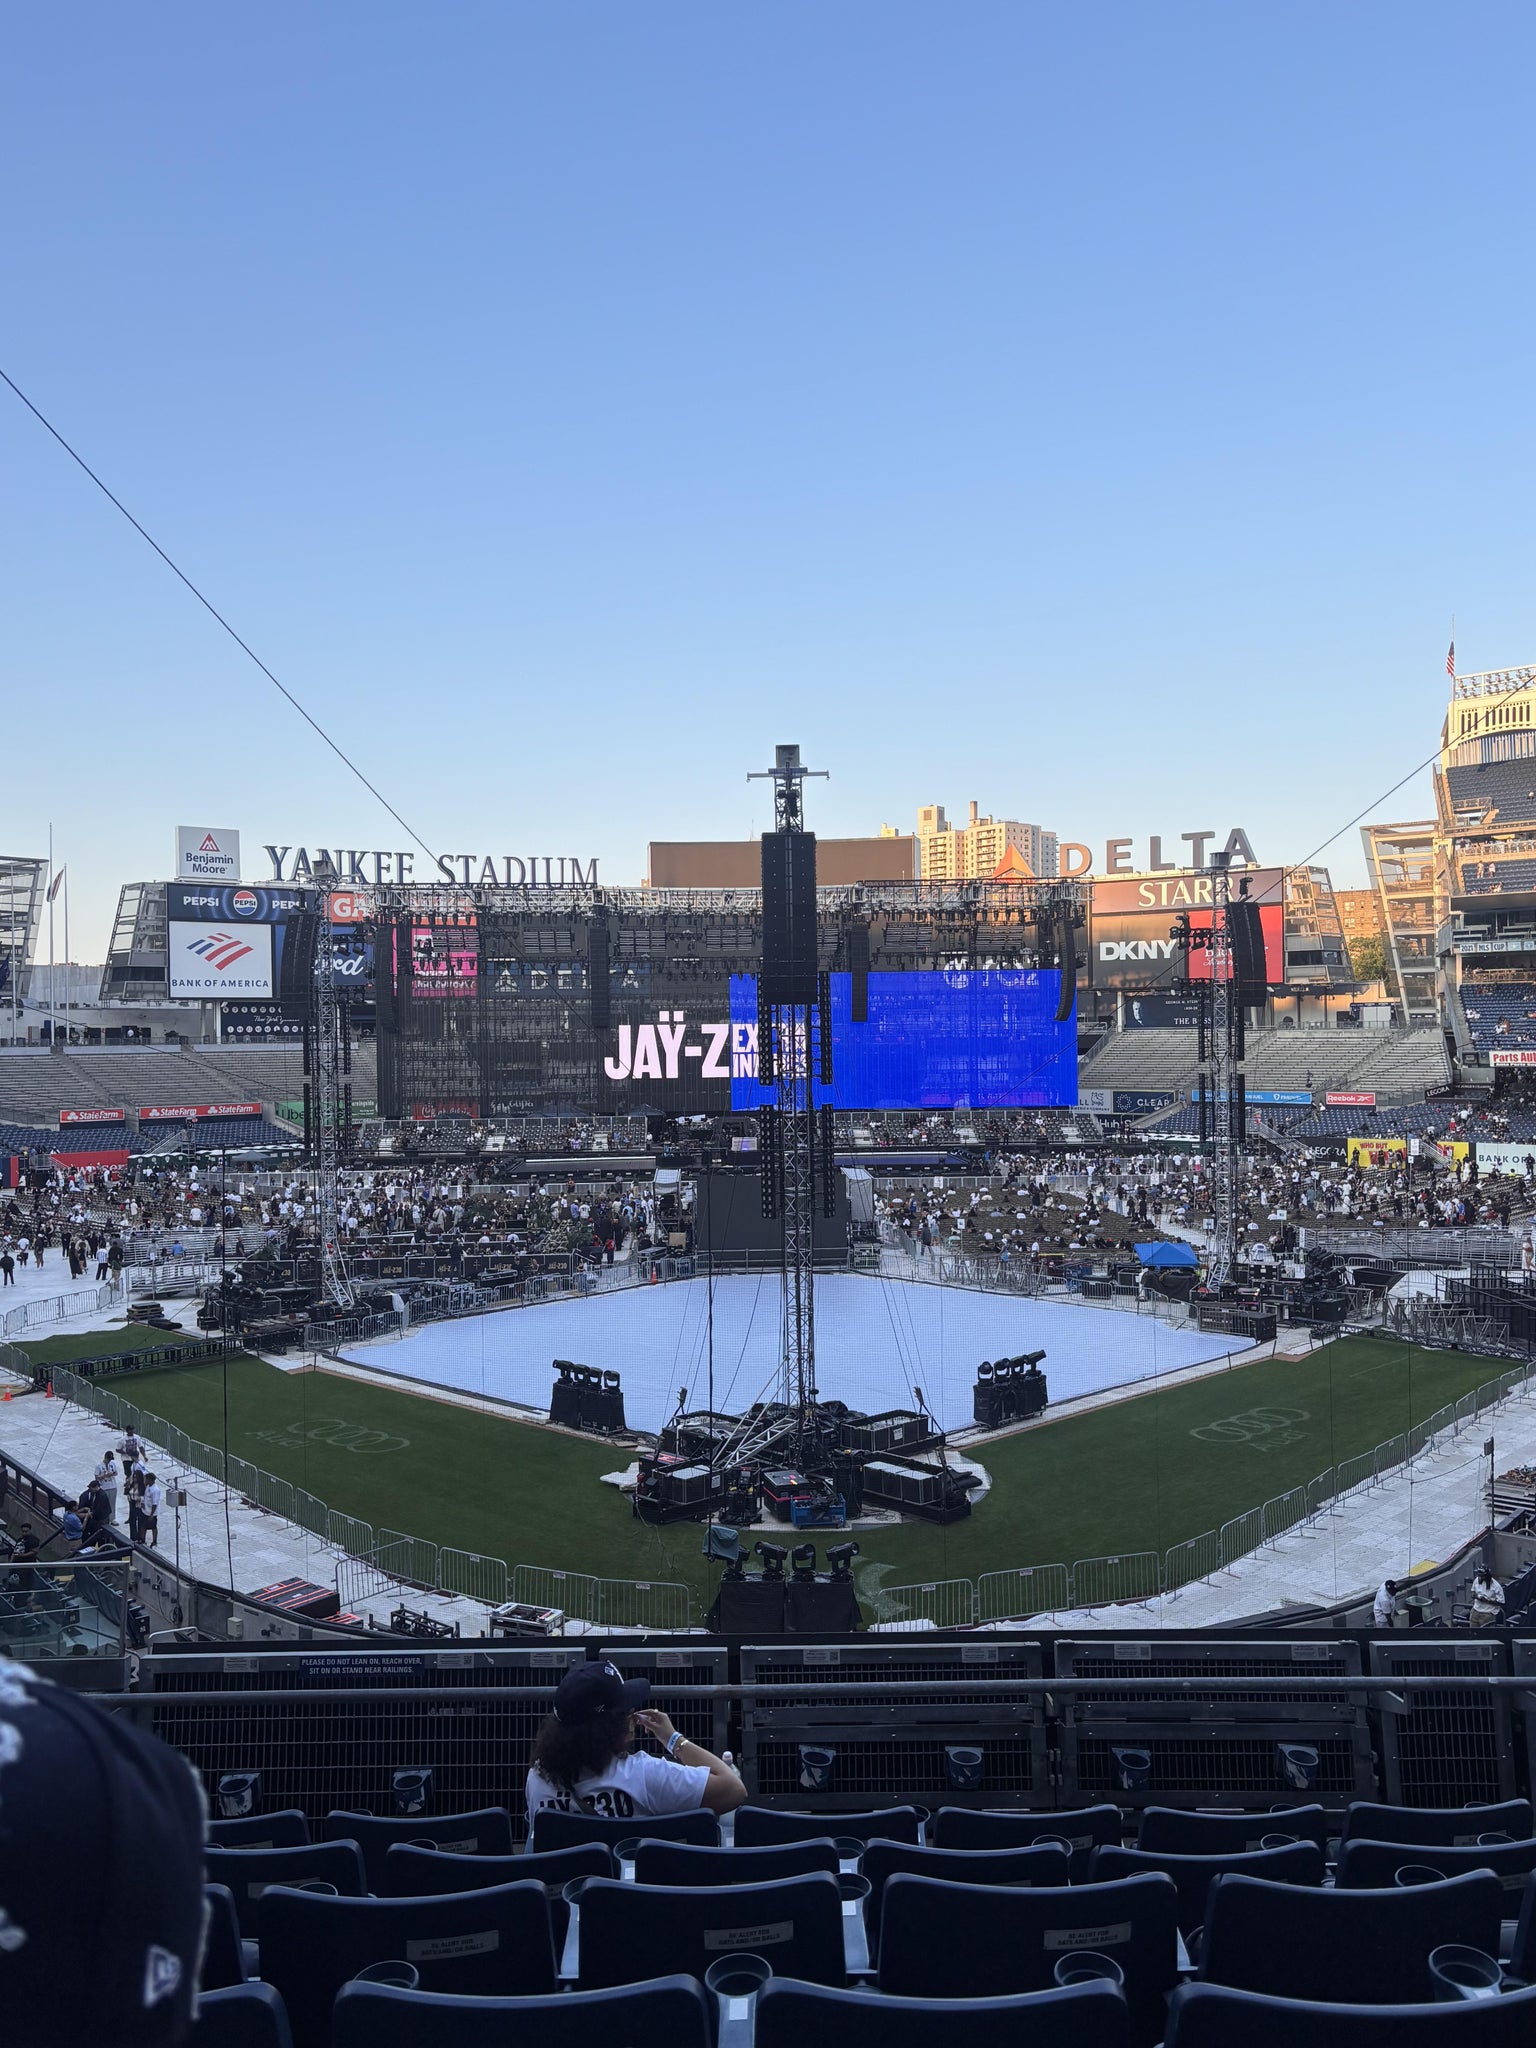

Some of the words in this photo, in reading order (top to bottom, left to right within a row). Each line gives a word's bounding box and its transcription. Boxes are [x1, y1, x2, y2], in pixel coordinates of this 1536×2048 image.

[1059, 827, 1257, 877] DELTA
[186, 853, 233, 866] Benjamin
[192, 864, 226, 875] Moore
[262, 845, 414, 884] YANKEE
[437, 853, 599, 889] STADIUM
[183, 896, 220, 907] PEPSI
[1099, 939, 1177, 961] DKNY
[1493, 943, 1505, 951] CUP
[172, 978, 201, 988] BANK
[205, 978, 217, 988] OF
[221, 979, 269, 989] AMERICA
[531, 969, 639, 990] DELA
[1173, 1017, 1190, 1025] THE
[1192, 1017, 1212, 1025] BSS
[1493, 1053, 1519, 1063] Parts
[1327, 1095, 1356, 1103] Reebok
[1360, 1142, 1375, 1150] WHO
[352, 1658, 368, 1666] LEAN
